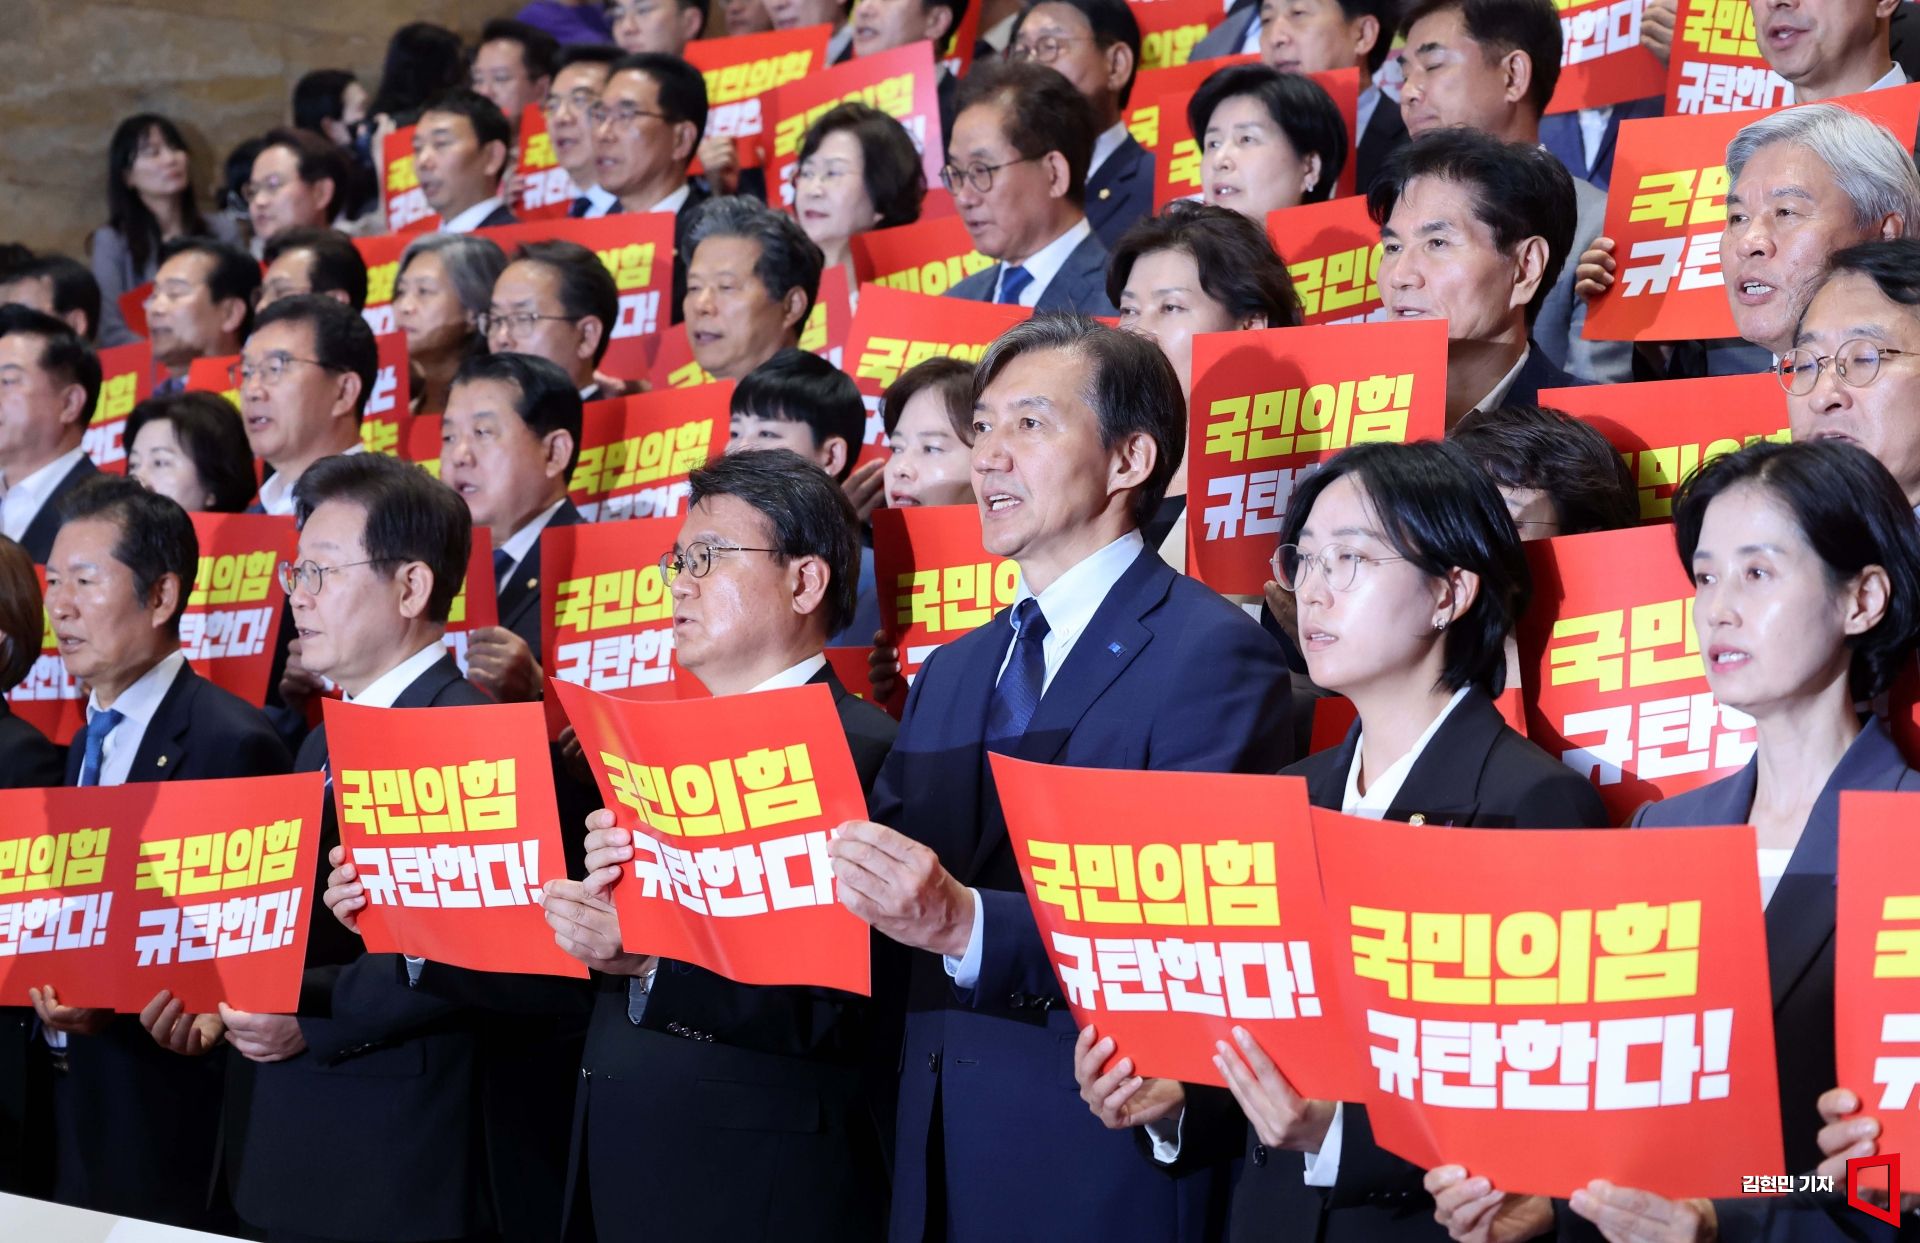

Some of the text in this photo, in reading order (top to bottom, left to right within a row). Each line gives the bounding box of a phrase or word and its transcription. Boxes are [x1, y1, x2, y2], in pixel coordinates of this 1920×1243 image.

[1677, 61, 1795, 115] 규탄한다
[1206, 374, 1414, 461] 국민의힘
[568, 420, 712, 493] 국민의힘
[188, 551, 276, 605] 민의힘
[555, 564, 673, 632] 국민의
[179, 607, 273, 660] 탄한다!
[556, 628, 675, 692] 규탄한
[1551, 598, 1704, 691] 국민
[342, 759, 516, 834] 국민의힘
[600, 744, 821, 836] 국민의힘
[0, 828, 111, 894] 민의힘
[136, 819, 302, 896] 국민의힘
[352, 839, 541, 909] 규탄한다!
[632, 829, 829, 917] 규탄한다
[1028, 840, 1280, 925] 국민의힘
[0, 892, 112, 956] 탄한다!
[136, 888, 302, 965] 규탄한다!
[1351, 901, 1701, 1004] 국민의힘
[1052, 932, 1321, 1018] 규탄한다!
[1368, 1009, 1732, 1110] 규탄한다!
